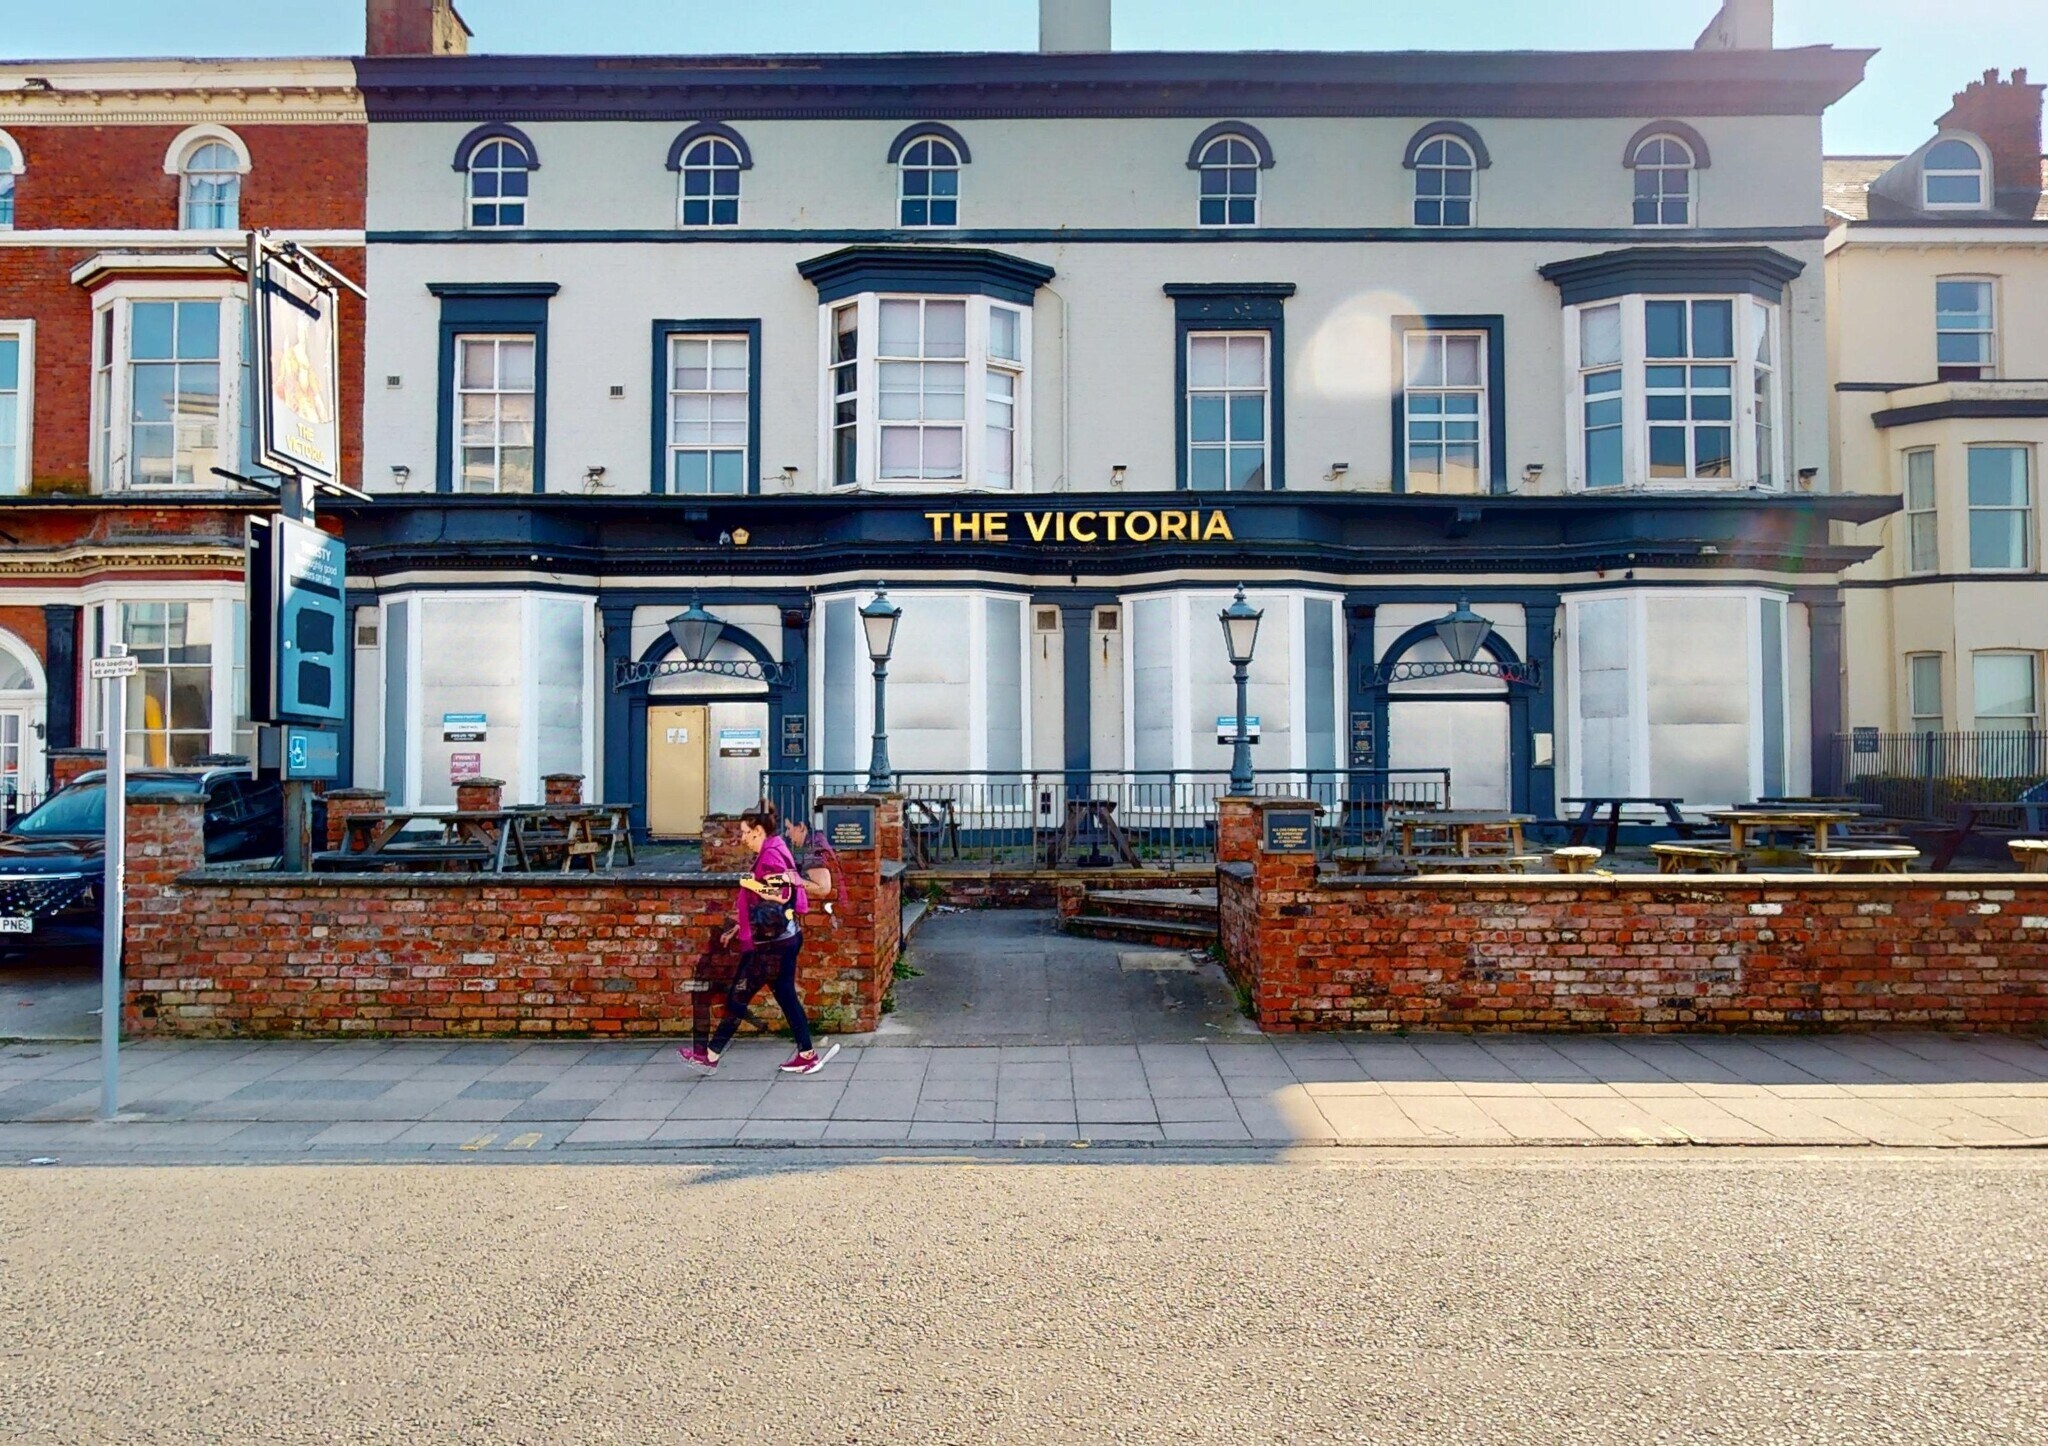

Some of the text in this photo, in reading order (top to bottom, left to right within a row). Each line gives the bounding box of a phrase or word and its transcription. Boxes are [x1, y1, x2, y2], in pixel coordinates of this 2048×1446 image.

[296, 423, 314, 442] THE
[924, 510, 1235, 541] THE VICTORIA
